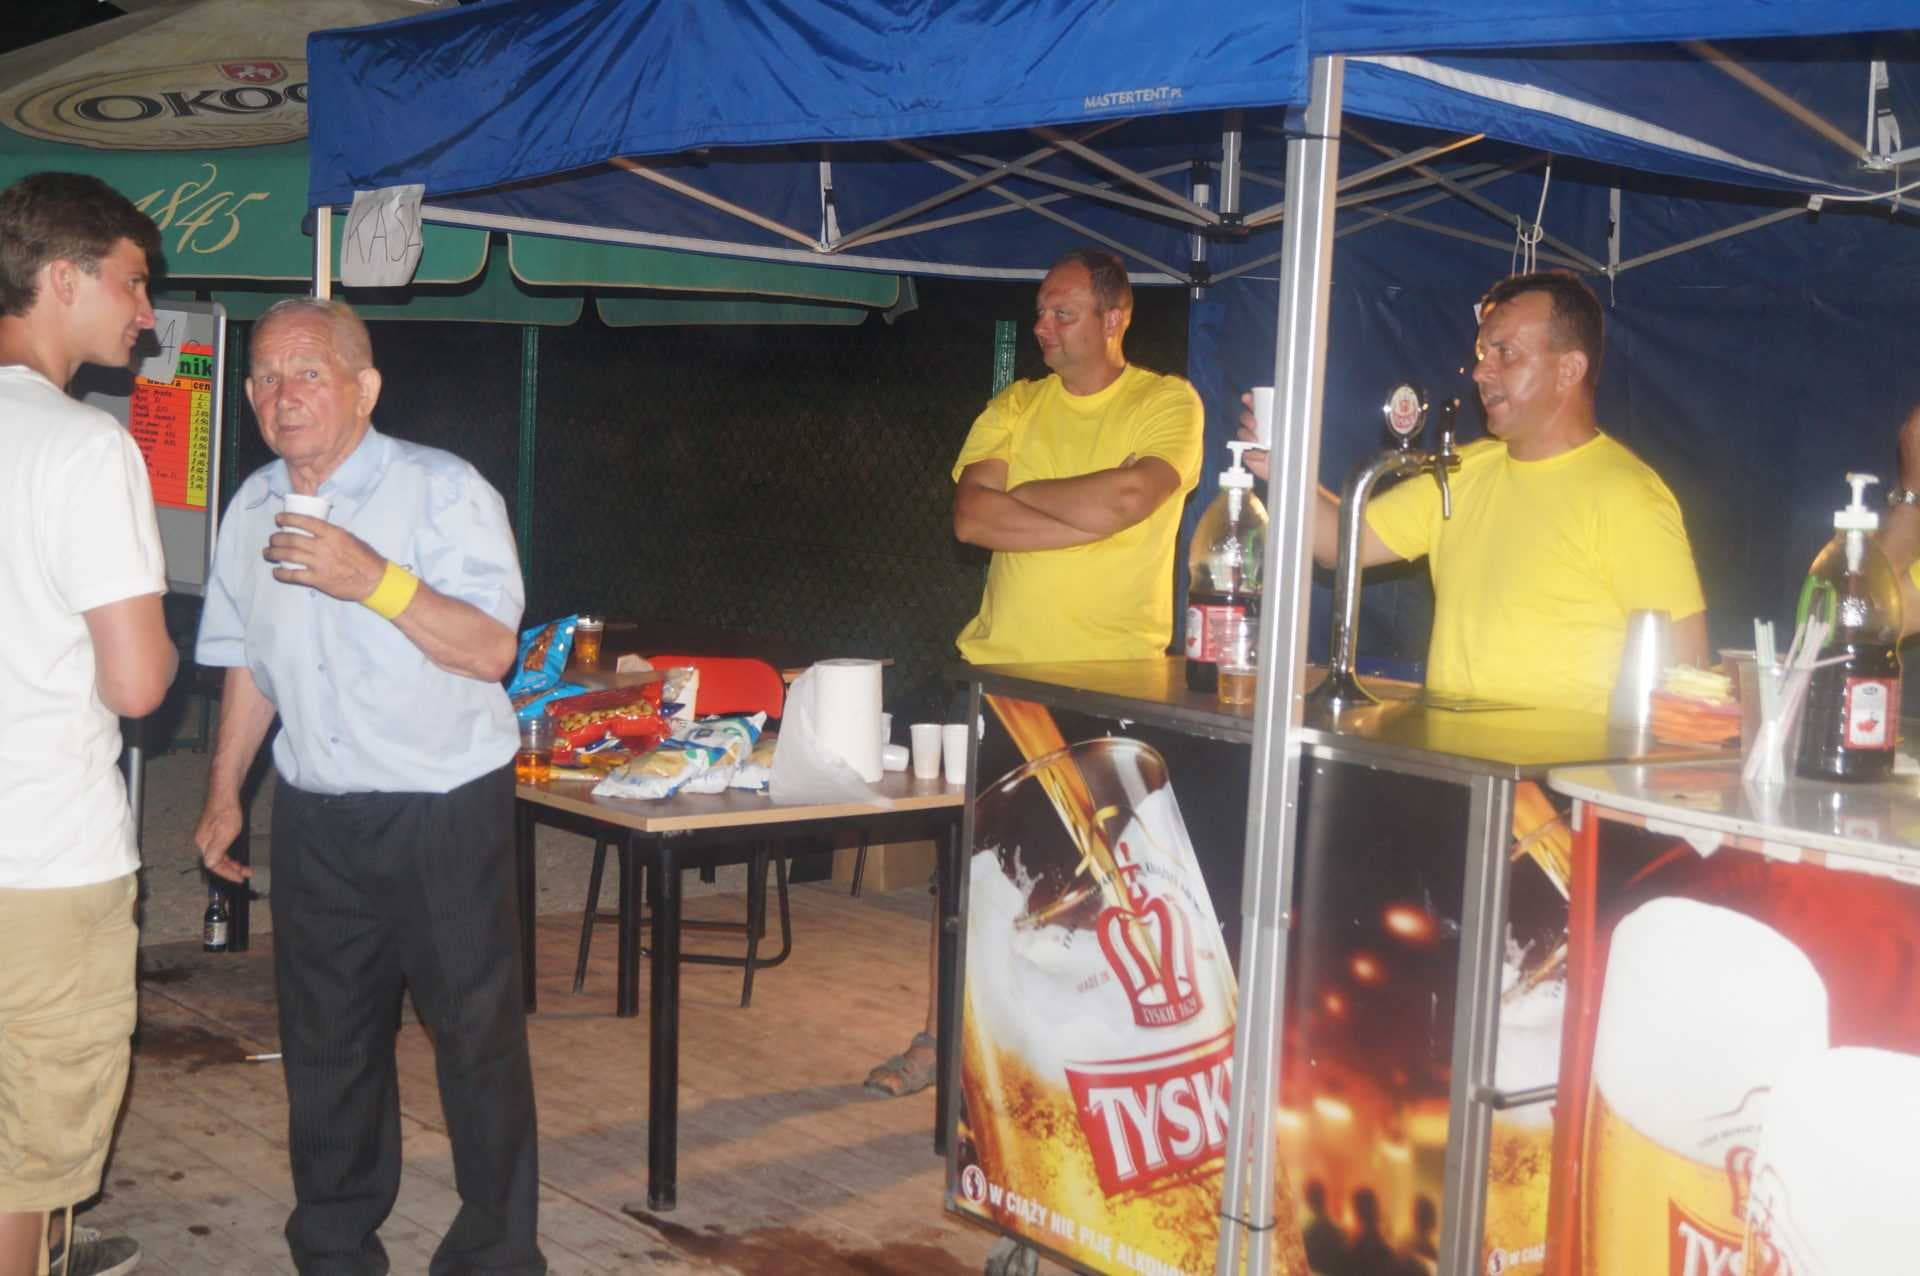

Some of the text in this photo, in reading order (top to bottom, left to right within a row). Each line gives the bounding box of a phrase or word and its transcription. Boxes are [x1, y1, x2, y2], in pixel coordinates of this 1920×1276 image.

[179, 358, 212, 377] nik
[1084, 1057, 1233, 1182] TYSK
[989, 1183, 1003, 1207] W
